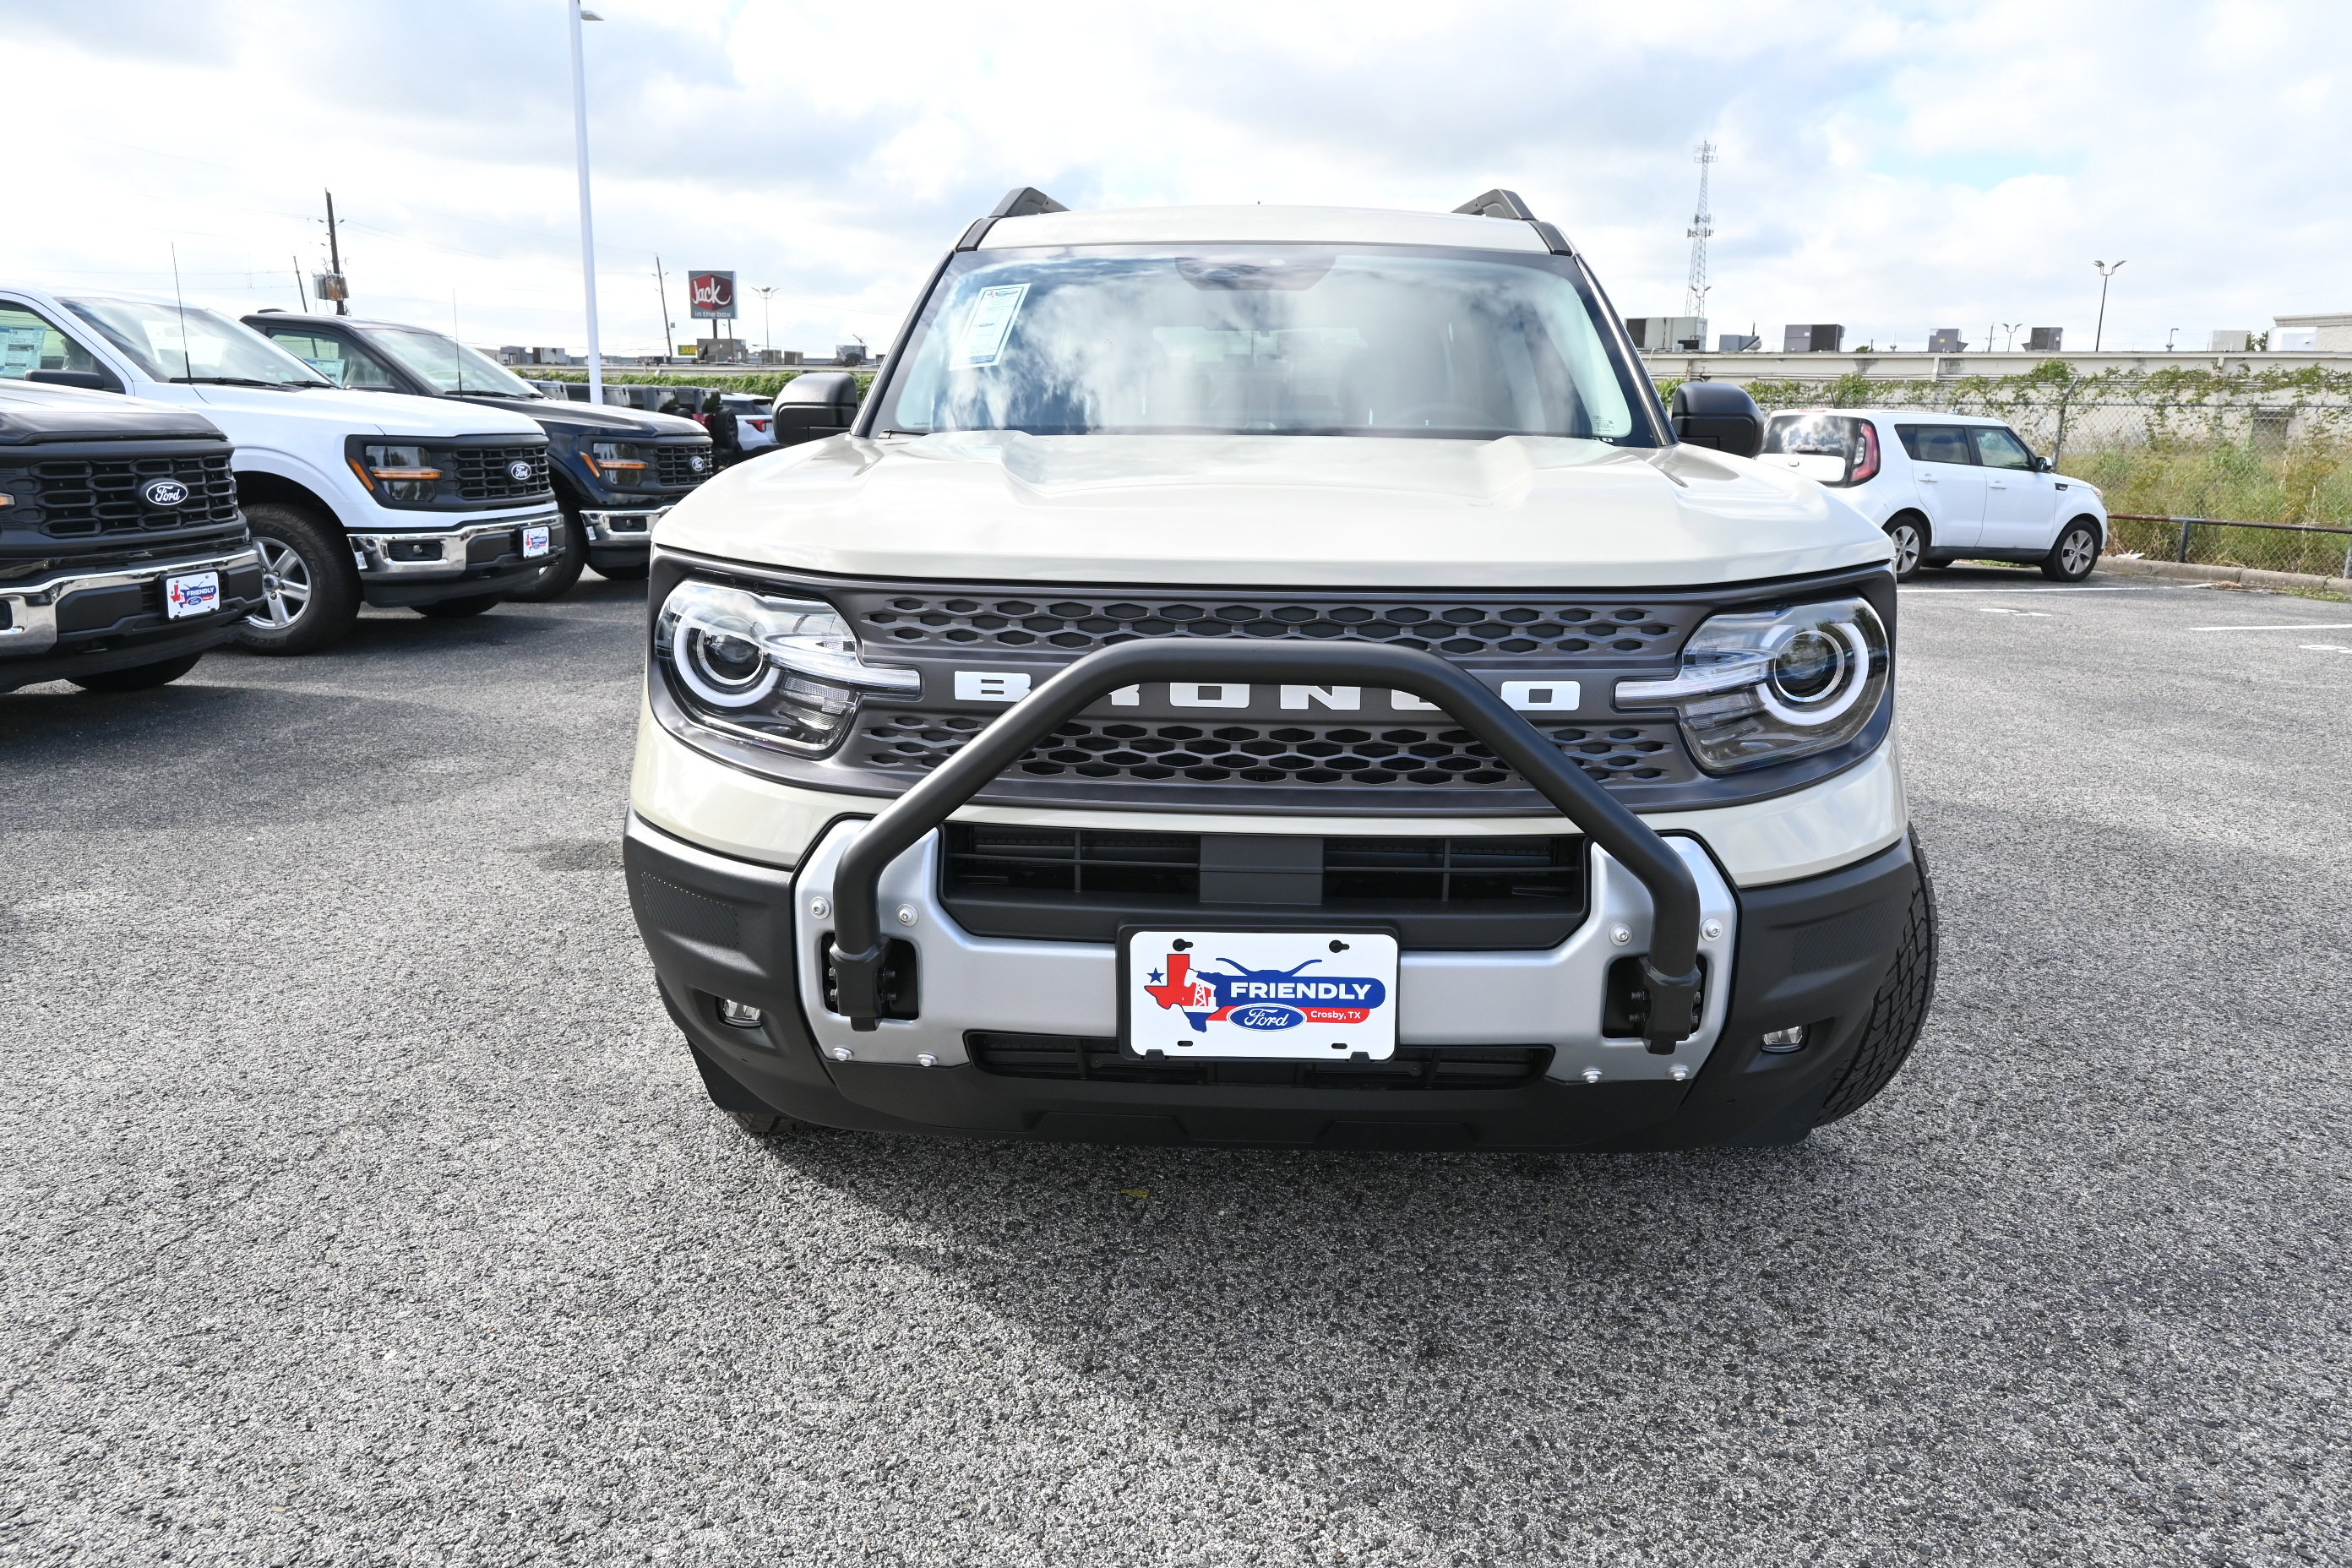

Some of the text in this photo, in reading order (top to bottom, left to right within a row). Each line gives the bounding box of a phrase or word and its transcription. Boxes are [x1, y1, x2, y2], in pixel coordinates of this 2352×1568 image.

[692, 277, 731, 305] Jack
[155, 485, 181, 502] Ford
[186, 586, 215, 597] FRIENDLY
[1230, 982, 1372, 1000] FRIENDLY
[1244, 1008, 1289, 1027] Ford
[1310, 1010, 1361, 1021] Crosby, TX
